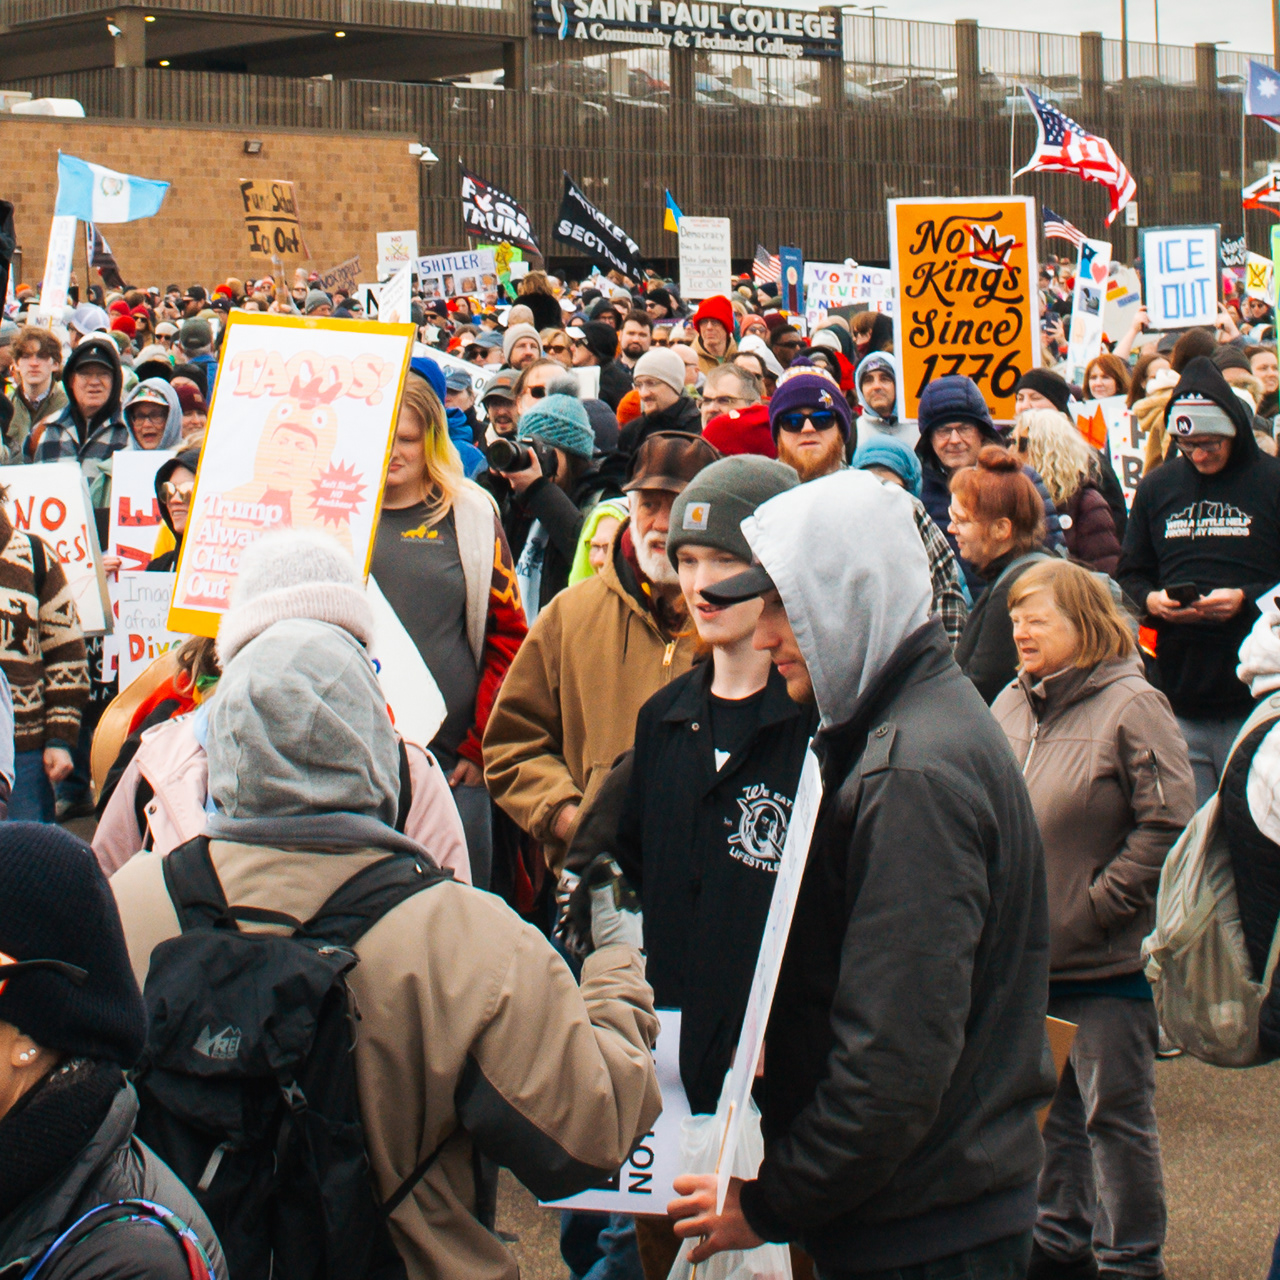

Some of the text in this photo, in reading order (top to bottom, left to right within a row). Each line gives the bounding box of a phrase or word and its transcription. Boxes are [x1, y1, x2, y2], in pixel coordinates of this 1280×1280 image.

[660, 1, 724, 29] PAUL
[730, 7, 836, 39] COLLEGE
[574, 22, 804, 58] A Community & Technical College
[463, 201, 535, 245] TRUM
[680, 226, 725, 241] Democracy
[909, 210, 1003, 256] No
[391, 235, 402, 243] NO
[557, 220, 628, 274] SECTION
[385, 254, 410, 262] KINGS
[421, 254, 480, 275] SHITLER
[1158, 238, 1205, 274] ICE
[684, 267, 722, 277] Trump Out
[689, 278, 722, 289] Ice Out
[814, 269, 883, 285] VOTING
[905, 259, 1024, 308] Kings
[811, 282, 892, 299] PREVENS
[1161, 277, 1211, 319] OUT
[809, 299, 893, 316] UNWED
[908, 307, 1023, 348] Since
[229, 349, 396, 406] TACOS!
[915, 350, 1021, 400] 1776
[320, 478, 337, 490] Soft
[330, 490, 344, 499] NO
[14, 496, 67, 532] NO
[204, 491, 283, 526] Trump
[1196, 517, 1224, 527] LITTLE
[56, 524, 94, 569] GS!
[196, 520, 264, 548] Alwa
[191, 546, 241, 572] Chic
[123, 575, 171, 610] Imag
[186, 571, 230, 601] Out
[728, 846, 781, 873] LIFESTYLE
